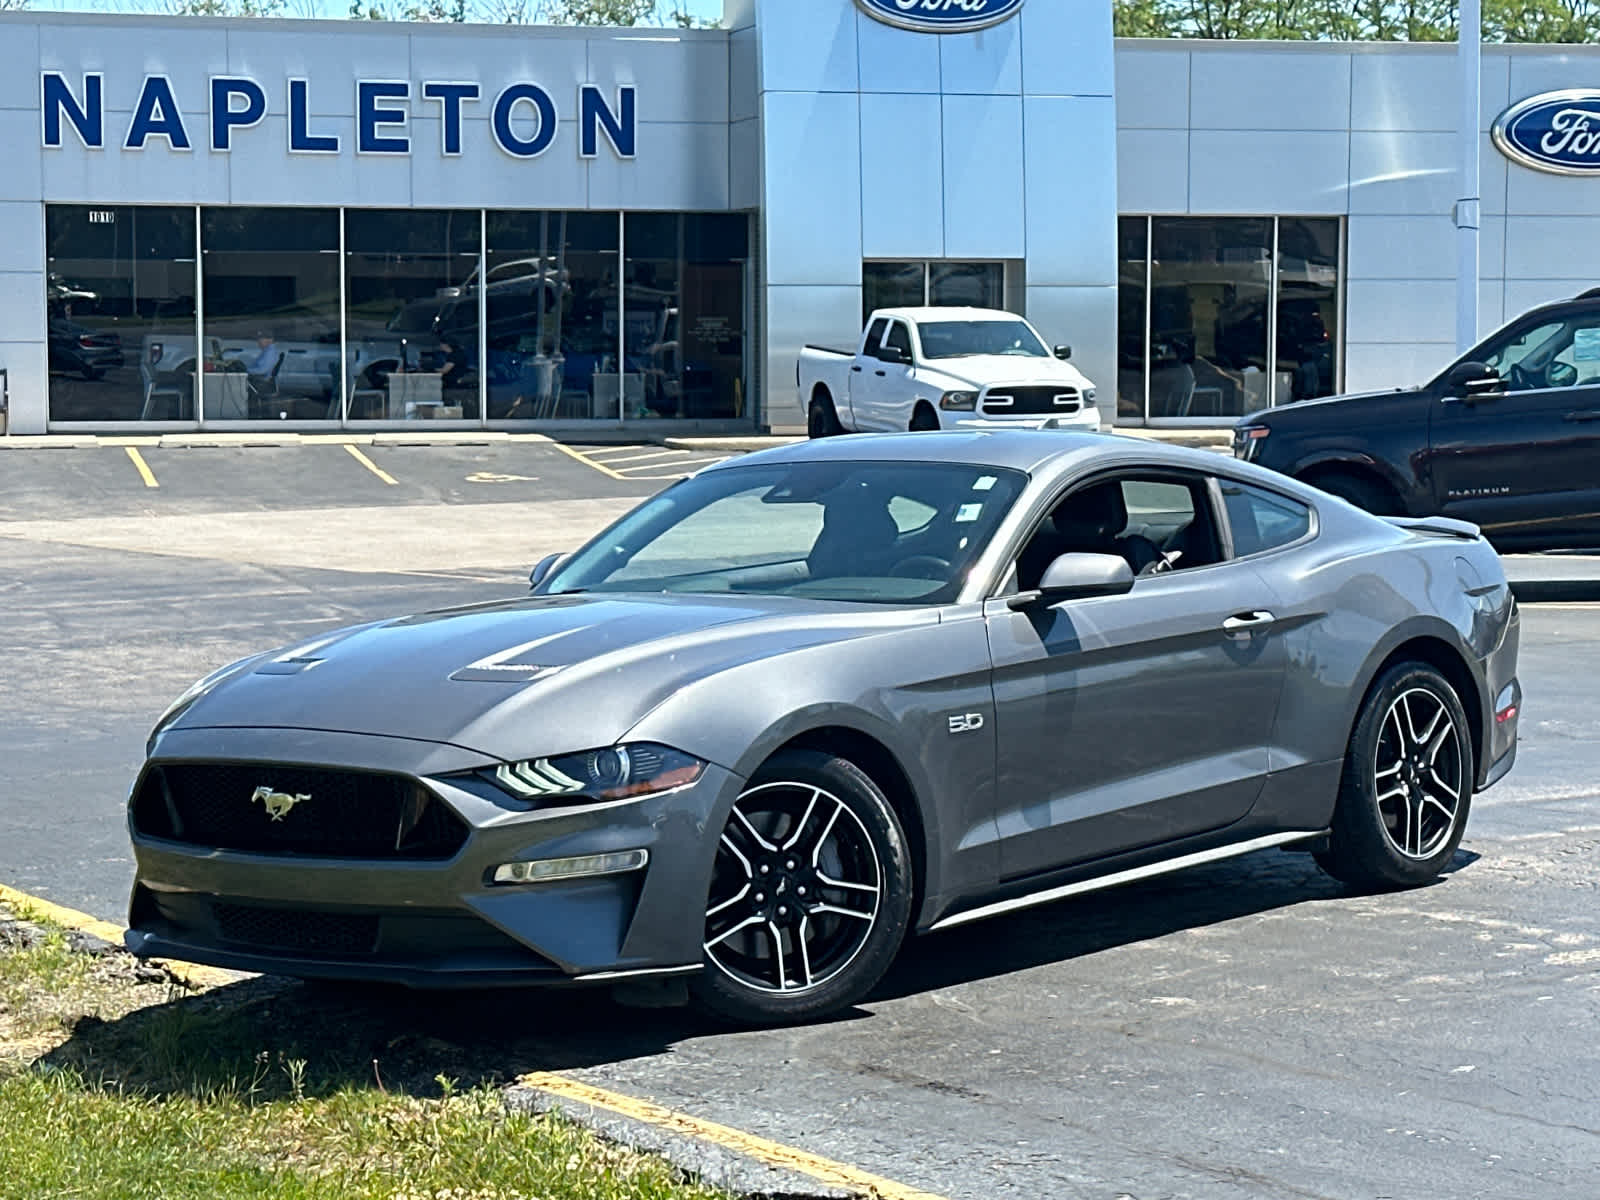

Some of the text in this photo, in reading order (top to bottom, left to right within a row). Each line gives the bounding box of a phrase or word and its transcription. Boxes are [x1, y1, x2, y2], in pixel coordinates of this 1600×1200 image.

[40, 71, 637, 158] NAPLETON
[90, 211, 114, 223] 1010
[1448, 487, 1510, 496] PLATINUM
[948, 713, 984, 733] 5.0
